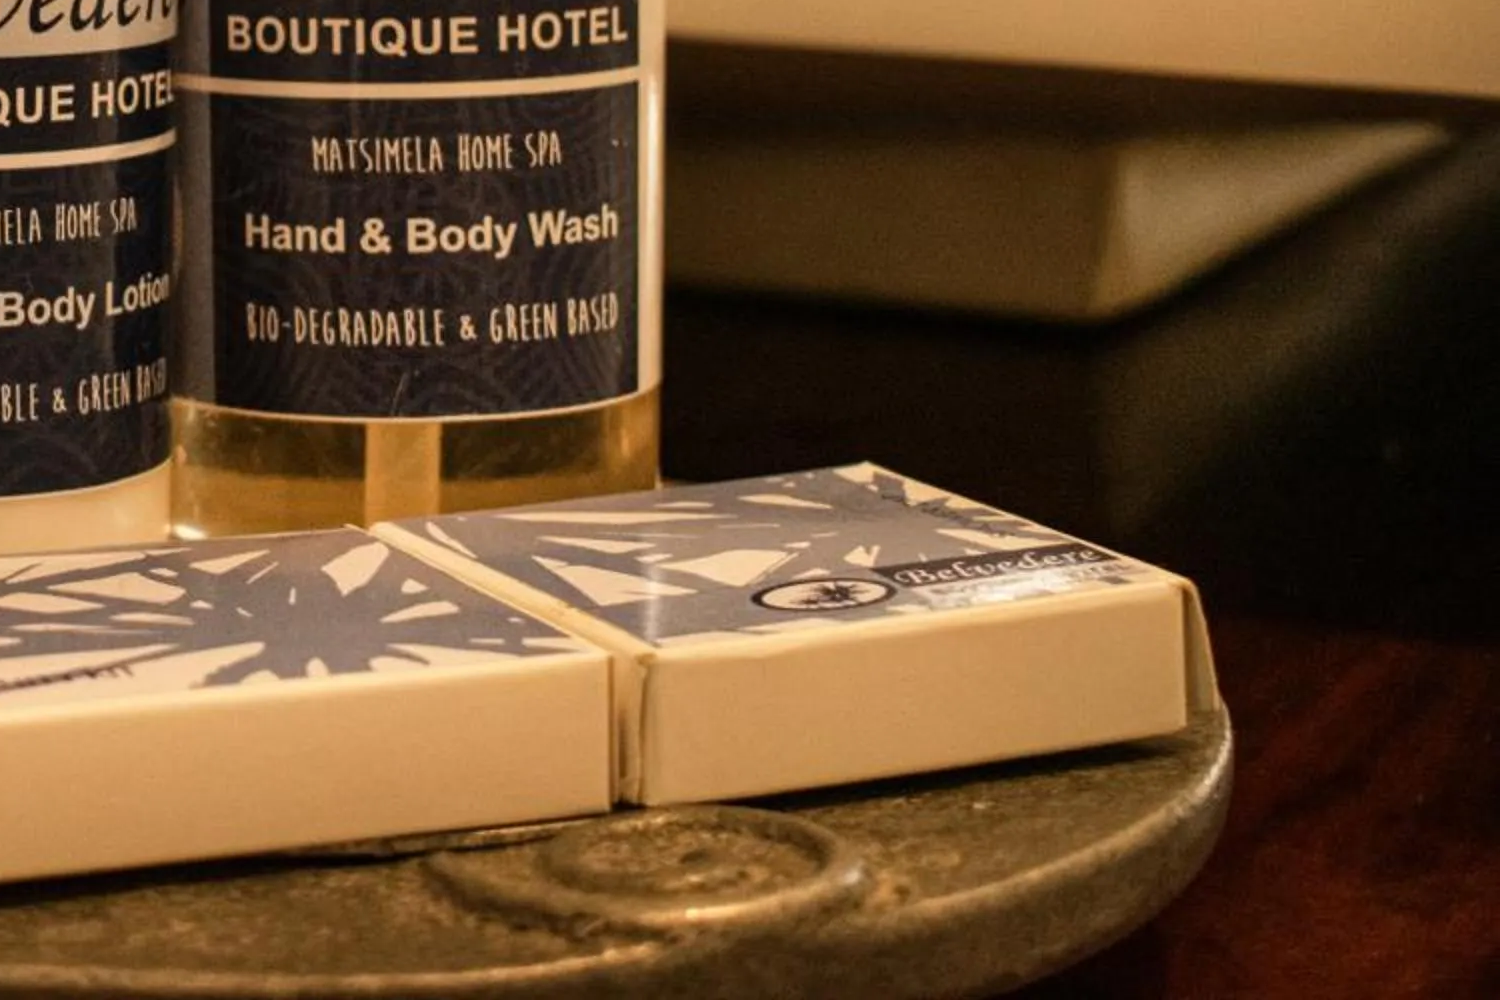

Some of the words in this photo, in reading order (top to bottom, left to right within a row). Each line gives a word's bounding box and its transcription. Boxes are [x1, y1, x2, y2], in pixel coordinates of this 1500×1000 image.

[227, 15, 478, 58] BOUTIQUE
[499, 6, 628, 53] HOTEL
[91, 69, 175, 119] HOTEL
[311, 135, 444, 174] MATSIMELA
[458, 132, 513, 172] HOME
[525, 130, 562, 168] SPA
[55, 201, 101, 243] HOME
[110, 197, 137, 233] SPA
[245, 213, 346, 253] Hand
[360, 214, 392, 253] &
[406, 214, 517, 260] Body
[529, 203, 619, 247] Wash
[105, 272, 170, 317] Lotion
[246, 303, 446, 346] BIO-DEGRADABLE
[459, 315, 478, 341] &
[490, 302, 557, 343] GREEN
[567, 292, 619, 338] BASED
[52, 389, 66, 414] &
[78, 369, 131, 415] GREEN
[893, 549, 1100, 586] Belvedere
